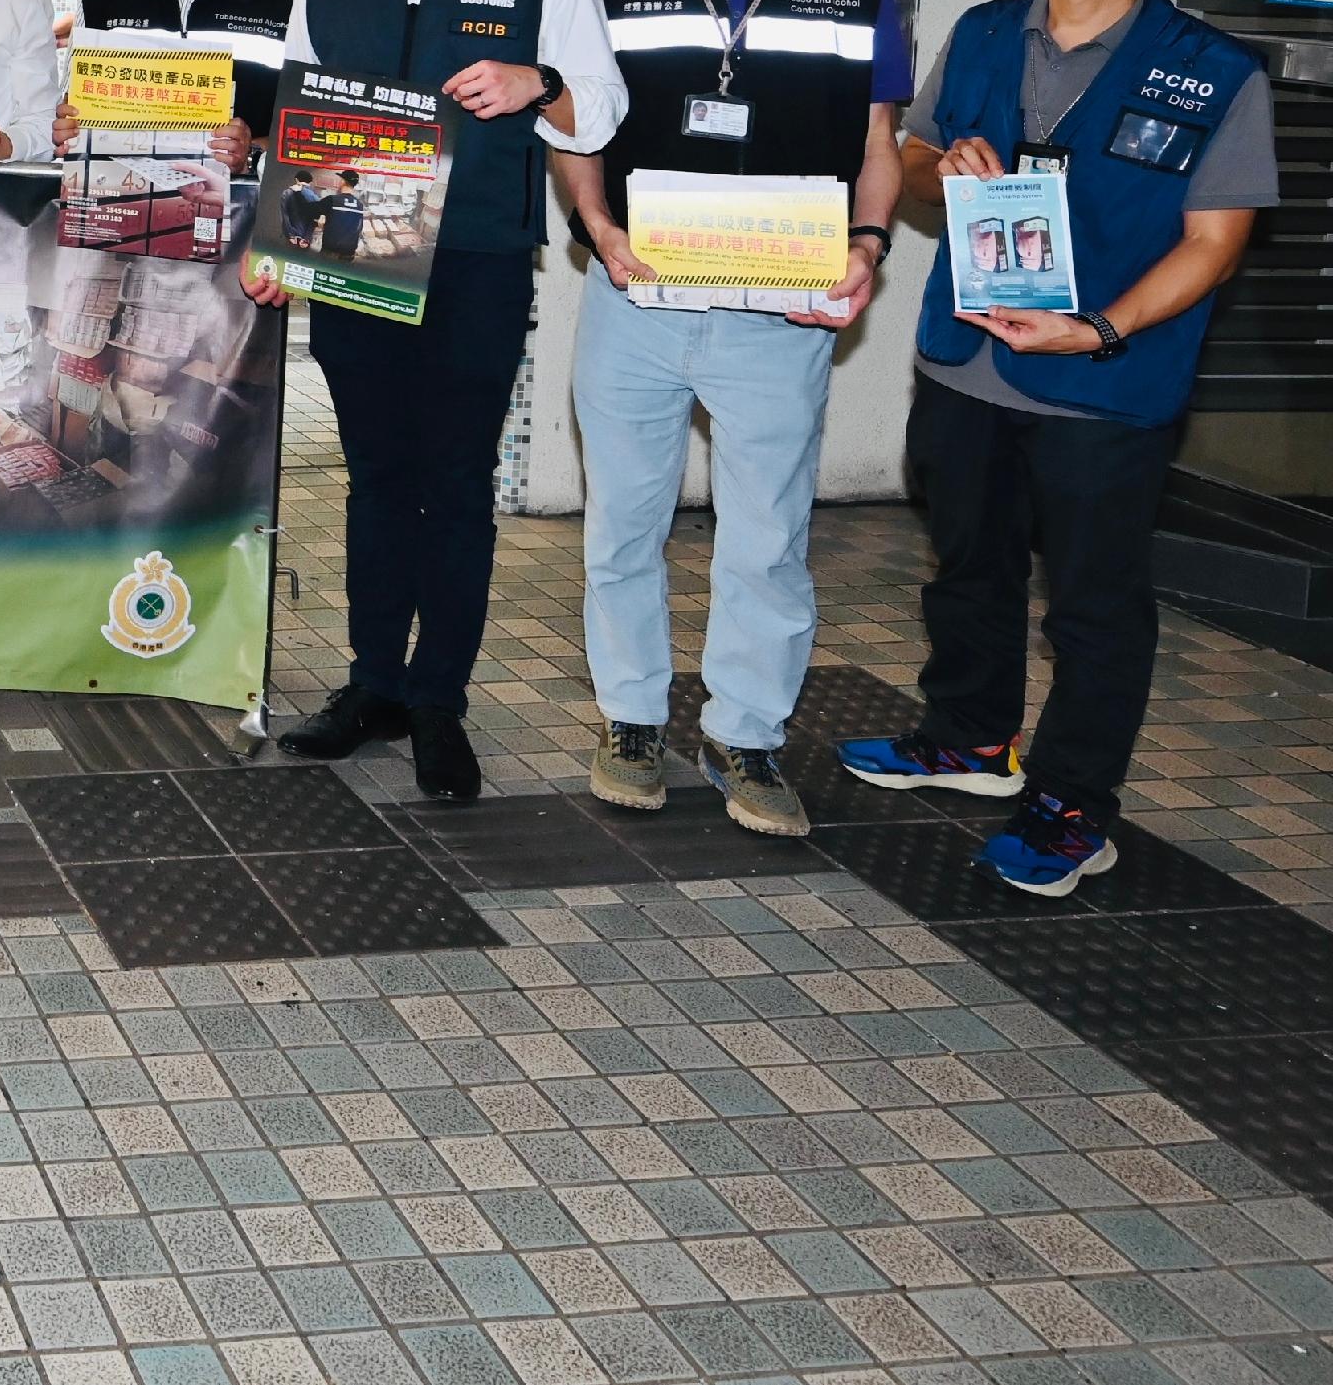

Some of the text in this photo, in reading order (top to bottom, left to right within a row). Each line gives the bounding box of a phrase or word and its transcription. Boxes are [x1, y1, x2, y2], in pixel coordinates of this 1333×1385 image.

[790, 4, 824, 16] Control
[461, 21, 507, 36] RCIB
[1147, 67, 1214, 97] PCRO
[1140, 85, 1207, 113] KT DIST
